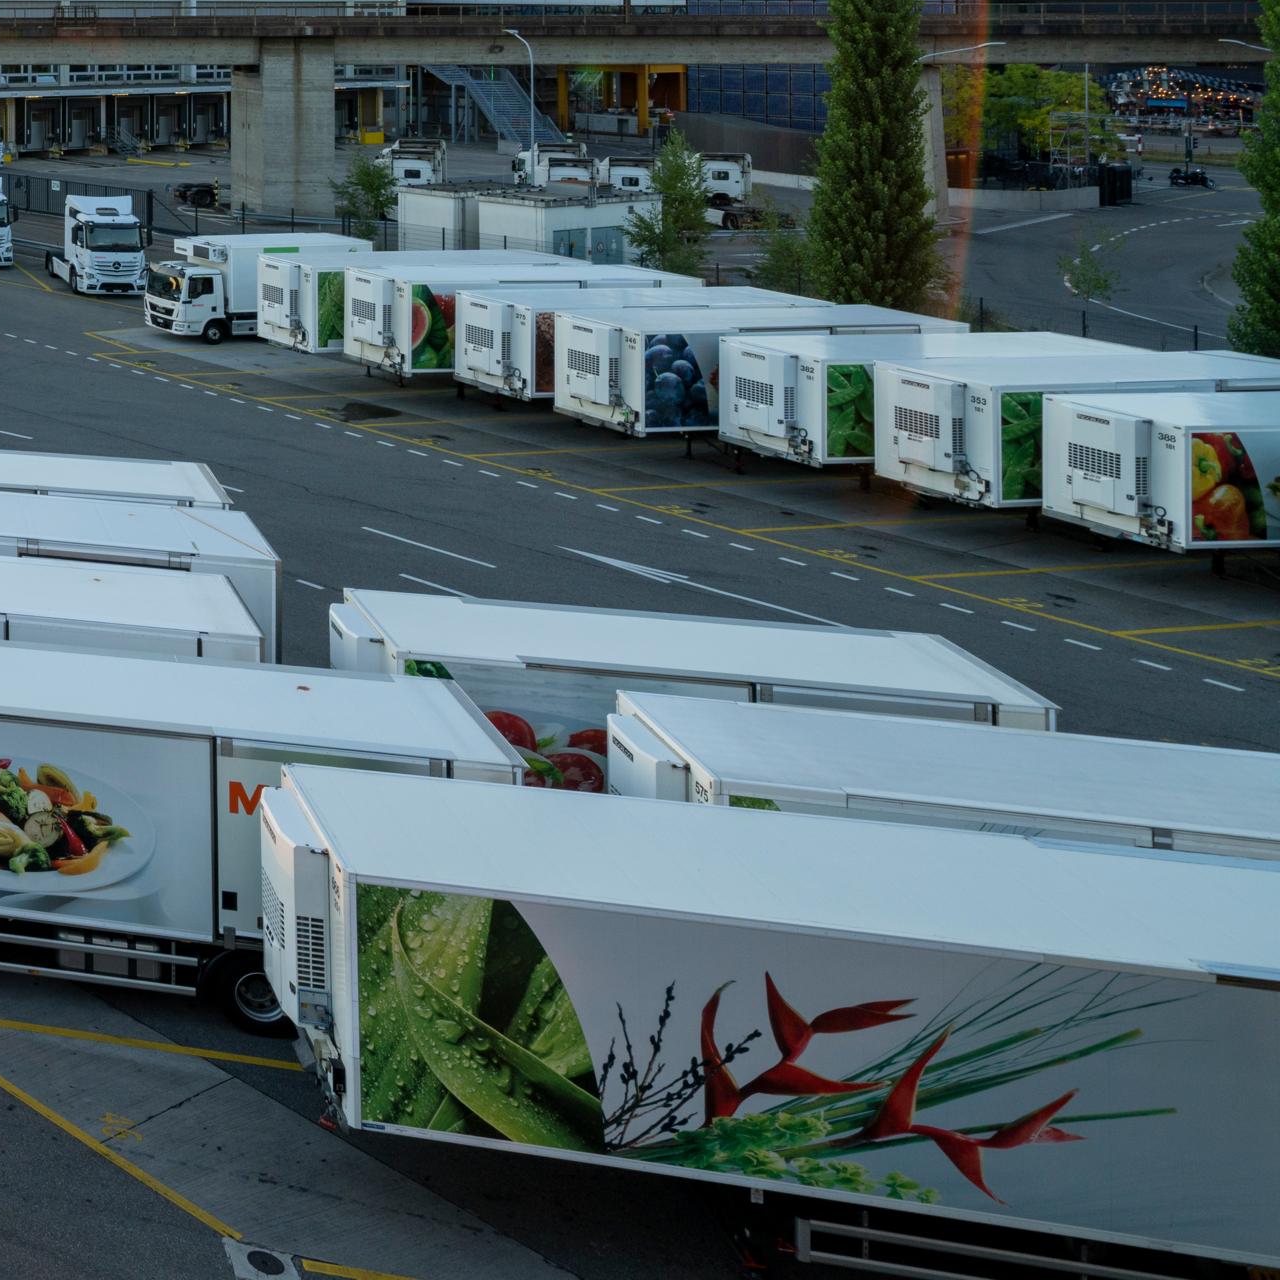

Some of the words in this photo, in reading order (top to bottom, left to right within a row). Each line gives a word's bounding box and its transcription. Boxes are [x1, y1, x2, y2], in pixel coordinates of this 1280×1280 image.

[970, 395, 987, 406] 353
[1158, 432, 1177, 444] 388
[695, 781, 709, 803] 575
